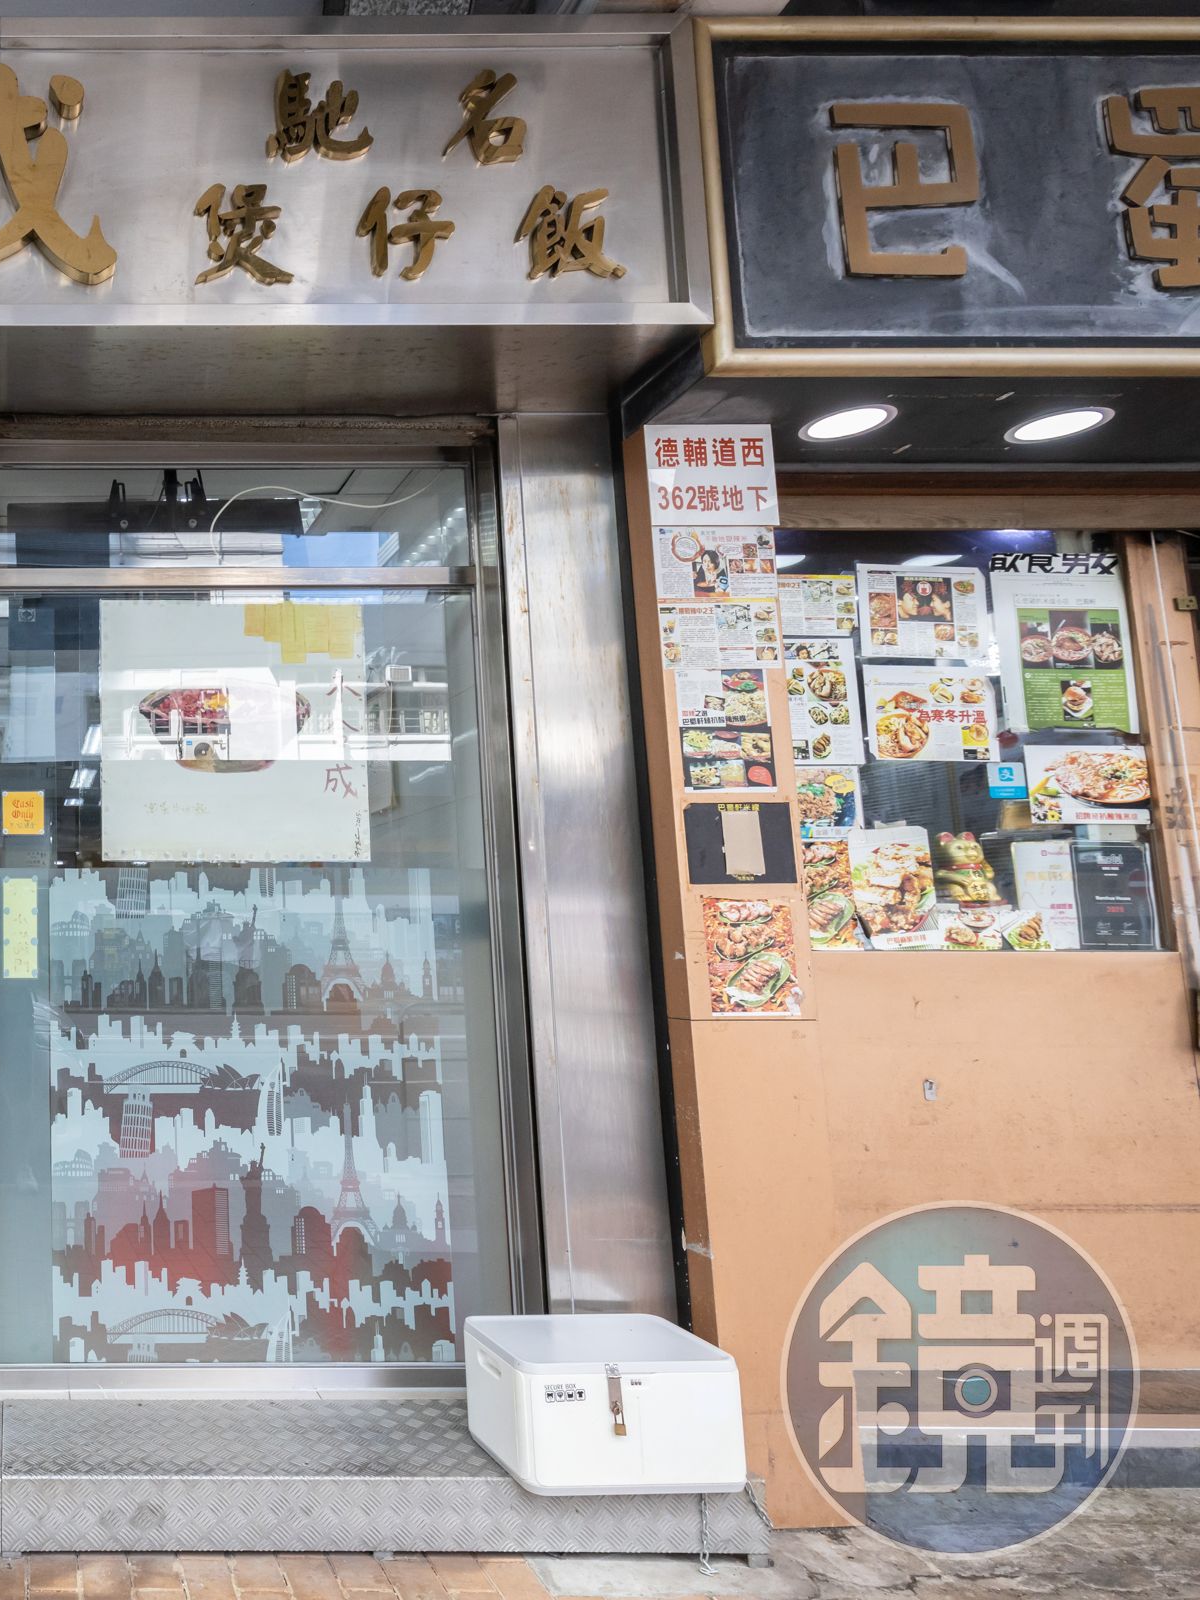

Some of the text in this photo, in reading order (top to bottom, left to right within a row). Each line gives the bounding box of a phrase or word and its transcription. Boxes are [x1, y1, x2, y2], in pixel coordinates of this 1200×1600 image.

[265, 68, 527, 166] 馳名
[194, 183, 627, 286] 煲仔飯
[654, 437, 765, 468] 德輔道西
[657, 485, 769, 512] 362號地下
[989, 552, 1119, 575] 飲食男女
[11, 798, 34, 808] Cash
